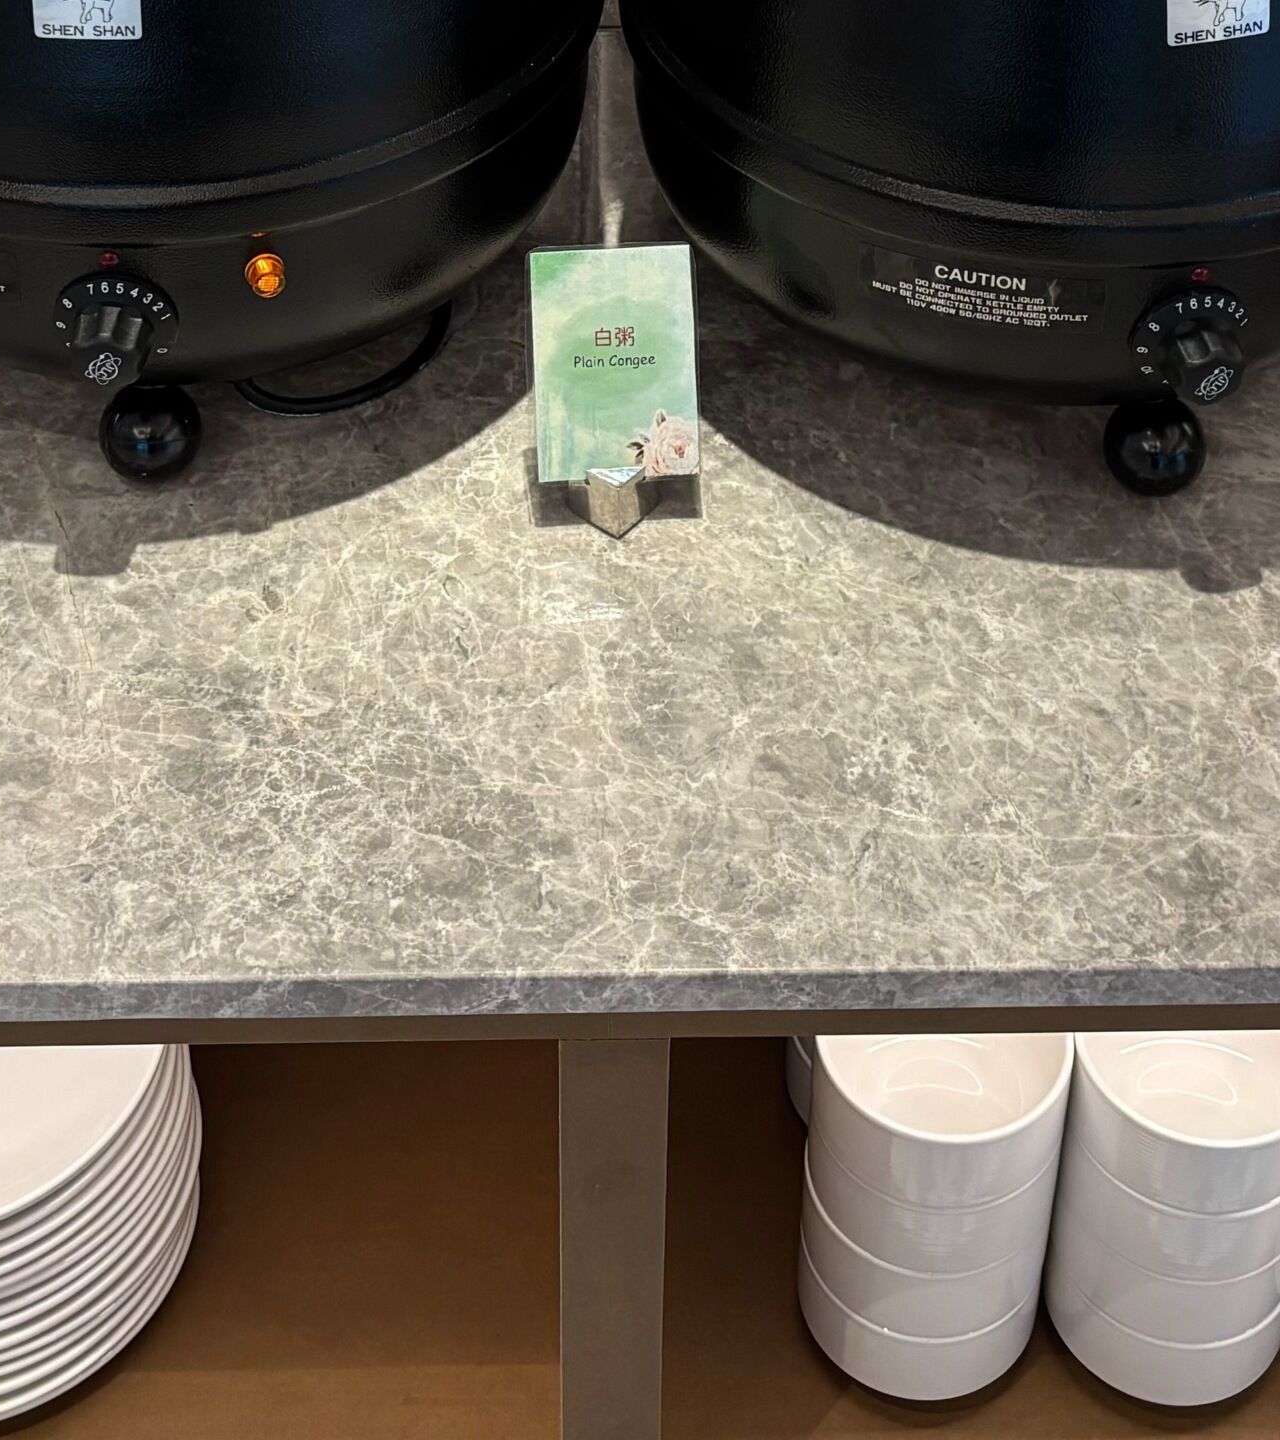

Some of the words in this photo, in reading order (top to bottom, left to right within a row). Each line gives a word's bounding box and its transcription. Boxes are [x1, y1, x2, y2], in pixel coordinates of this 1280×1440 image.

[42, 24, 84, 36] SHEN
[92, 25, 135, 37] SHAN
[1174, 28, 1216, 44] SHEN
[1223, 20, 1263, 38] SHAN
[934, 264, 1026, 291] CAUTION
[62, 298, 72, 309] 8
[86, 284, 94, 295] 7
[101, 282, 109, 293] 6
[116, 283, 124, 294] 5
[130, 287, 139, 298] 4
[143, 293, 153, 304] 3
[152, 302, 164, 311] 2
[872, 280, 897, 293] MUST
[899, 289, 912, 298] BE
[915, 293, 973, 310] CONNECTED
[976, 305, 989, 313] TO
[992, 307, 1047, 319] GROUNDED
[1049, 314, 1088, 322] OUTLET
[899, 281, 913, 290] DO
[915, 285, 935, 295] NOT
[938, 291, 983, 305] OPERATE
[986, 299, 1023, 310] KETTLE
[1026, 304, 1060, 313] EMPTY
[915, 278, 929, 287] DO
[931, 282, 951, 292] NOT
[1012, 295, 1045, 305] LIQUID
[906, 298, 927, 308] 110V
[930, 304, 957, 315] 400W
[1005, 317, 1019, 325] AC
[1136, 346, 1148, 354] 9
[1148, 322, 1160, 332] 8
[1176, 302, 1183, 314] 7
[1190, 298, 1198, 310] 6
[1204, 296, 1212, 308] 5
[1217, 298, 1225, 309] 4
[1228, 301, 1236, 312] 3
[1235, 308, 1244, 319] 2
[595, 326, 635, 347] 白粥
[574, 355, 605, 368] Plain
[609, 355, 656, 369] Congee
